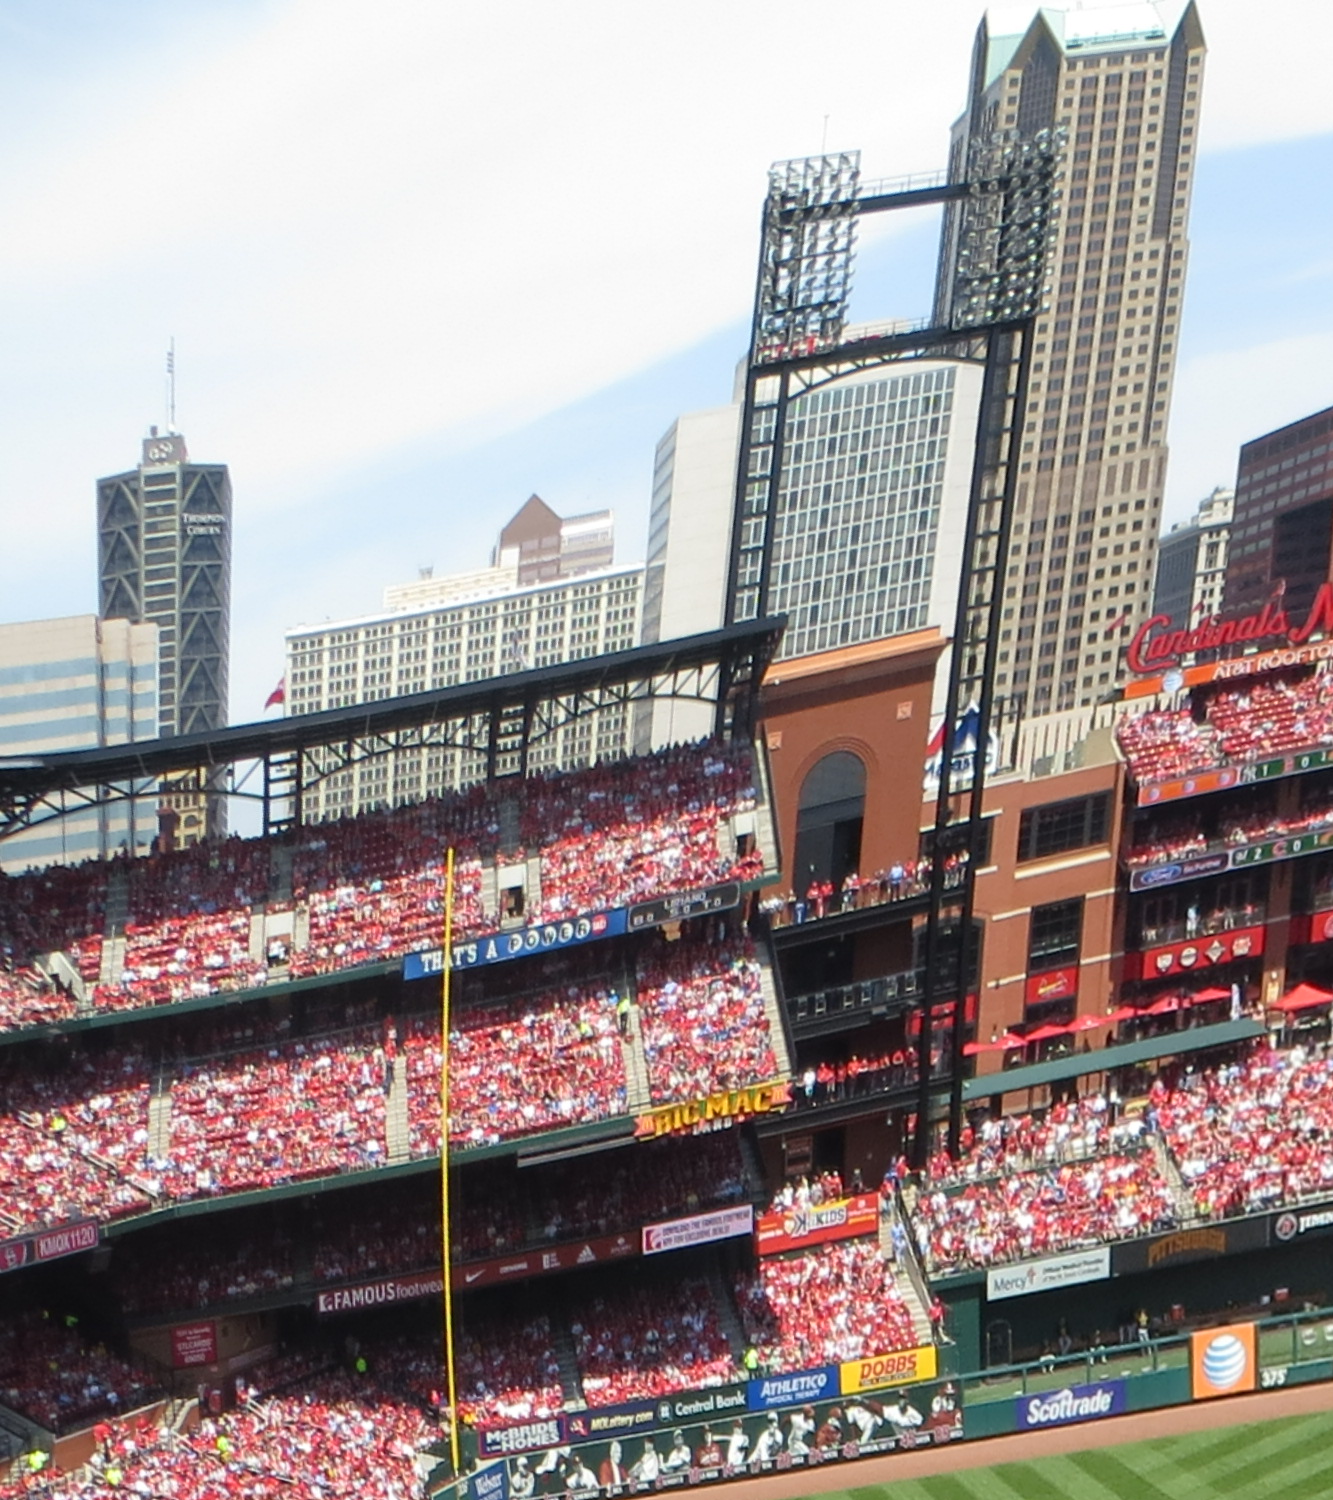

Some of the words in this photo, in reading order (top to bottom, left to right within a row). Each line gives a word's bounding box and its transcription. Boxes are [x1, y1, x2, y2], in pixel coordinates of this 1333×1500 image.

[1126, 603, 1291, 673] Cardinals
[1212, 660, 1255, 680] AT&T
[486, 940, 498, 961] A
[508, 918, 591, 955] POWER
[655, 1102, 700, 1137] BIG
[705, 1086, 774, 1120] MAC
[40, 1230, 70, 1256] KMOX
[70, 1226, 95, 1248] 1120
[1147, 1229, 1227, 1267] PITTSBURGH
[333, 1282, 396, 1310] FAMOUS
[994, 1277, 1027, 1291] Mercy
[860, 1354, 917, 1379] DOBBS
[761, 1372, 827, 1398] ATHLETICO
[675, 1396, 712, 1416] Central
[717, 1390, 746, 1408] Bank
[1027, 1389, 1114, 1425] Scottrade
[486, 1420, 559, 1444] McBRIDE
[502, 1434, 560, 1452] HOMES
